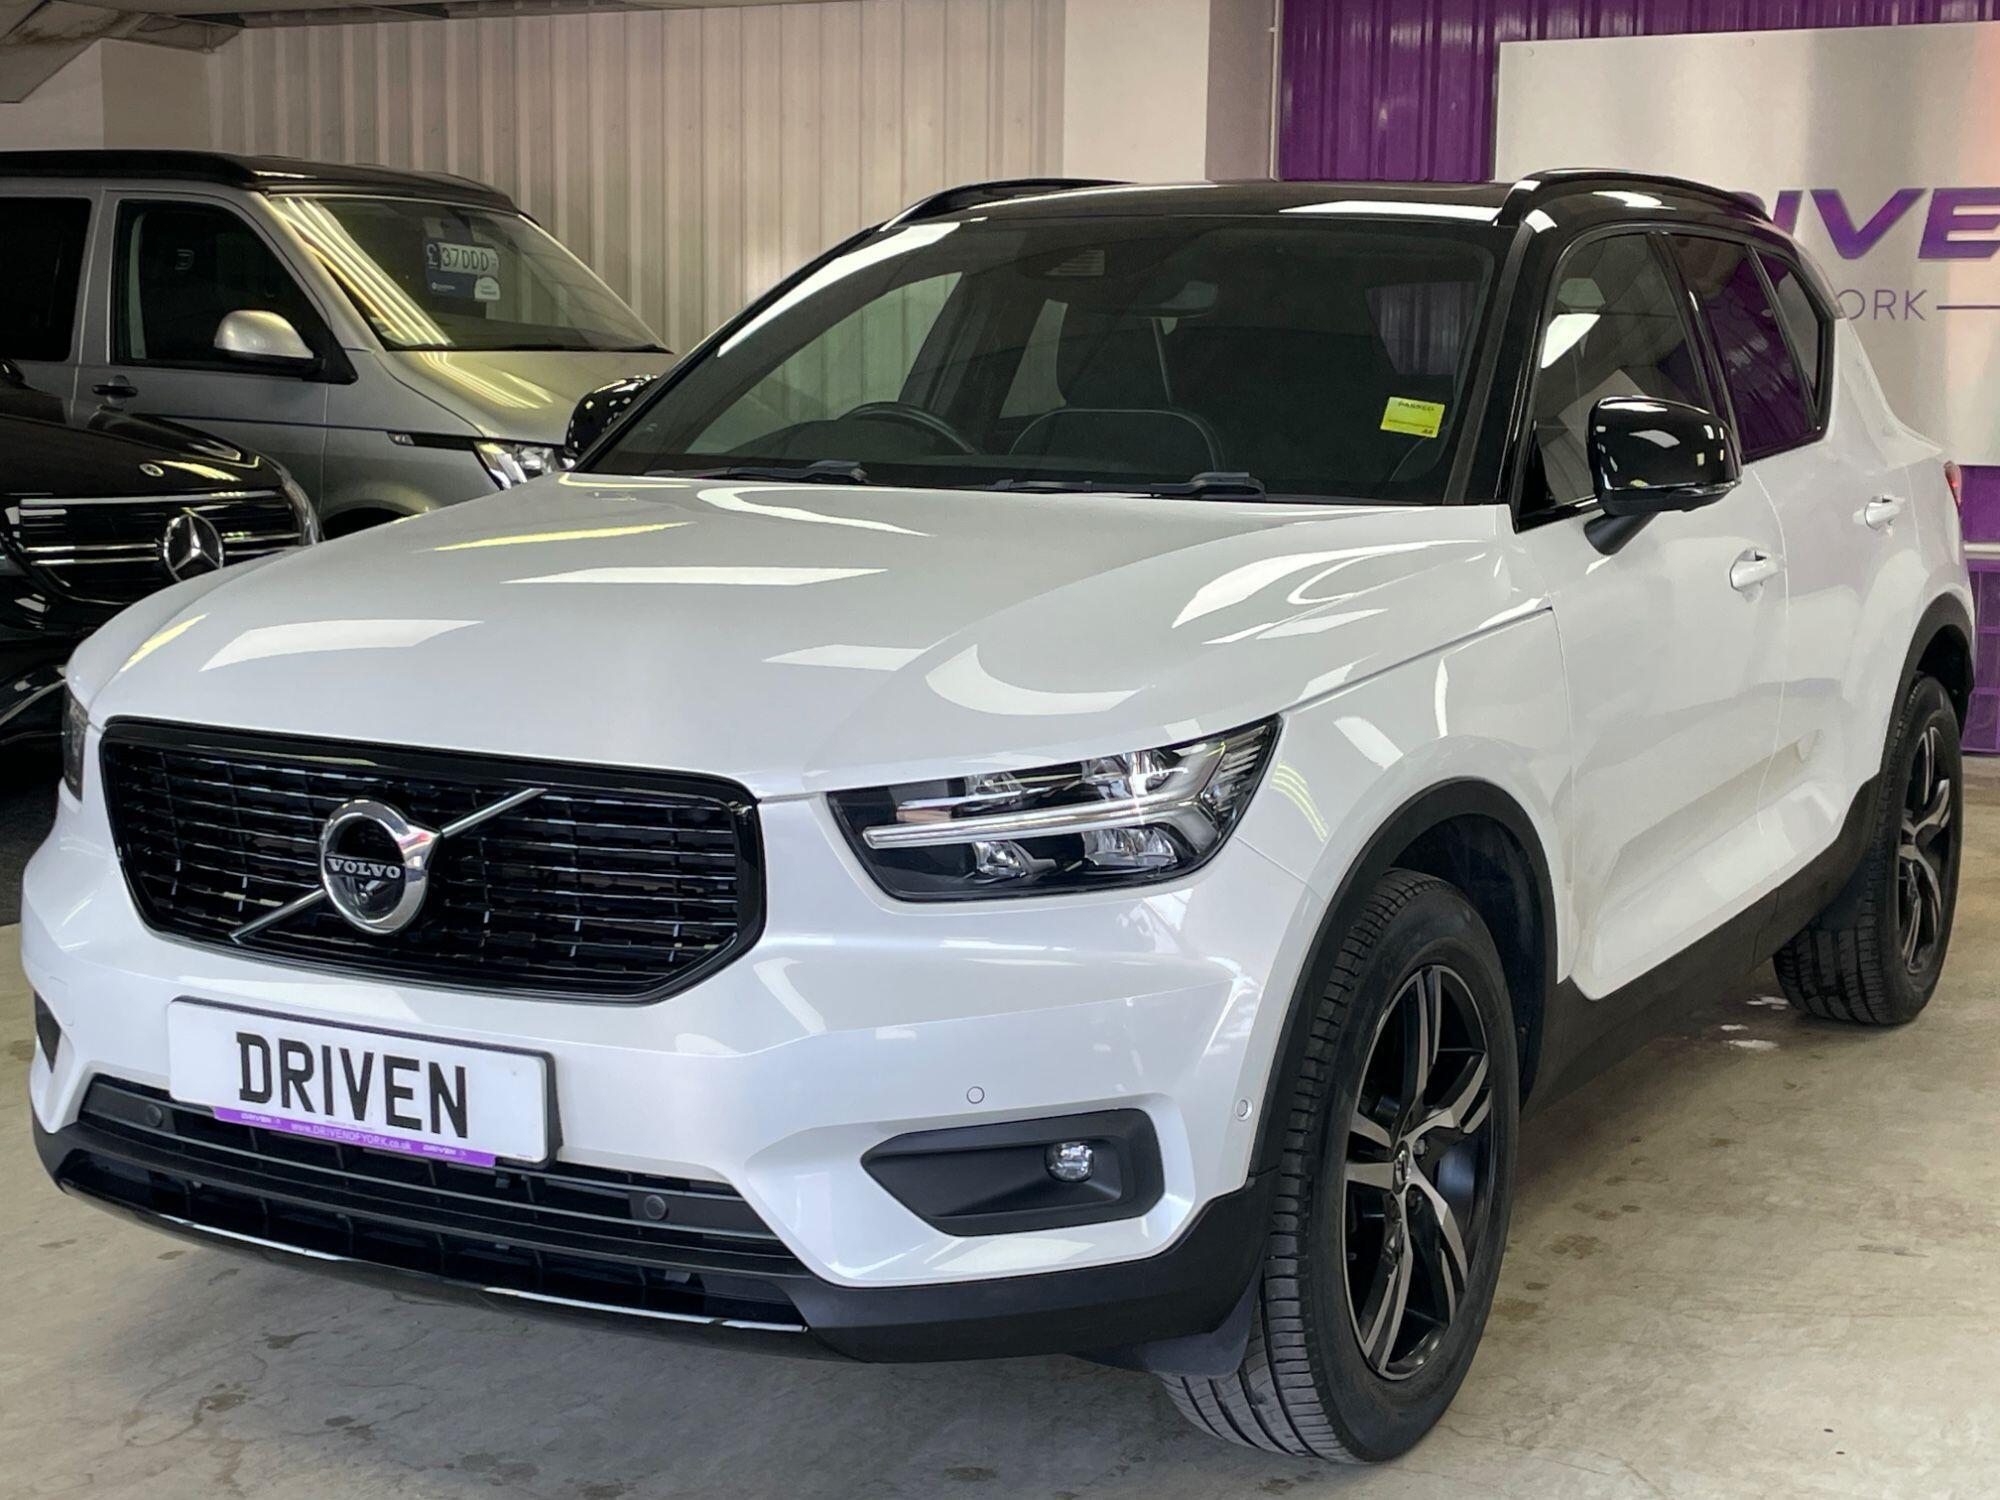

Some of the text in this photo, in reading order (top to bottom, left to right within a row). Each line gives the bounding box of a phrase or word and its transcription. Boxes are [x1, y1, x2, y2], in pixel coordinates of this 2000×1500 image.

[1729, 187, 2000, 260] IVE
[1835, 289, 1927, 321] ORK
[326, 858, 402, 879] VOLVO
[236, 1031, 469, 1139] DRIVEN
